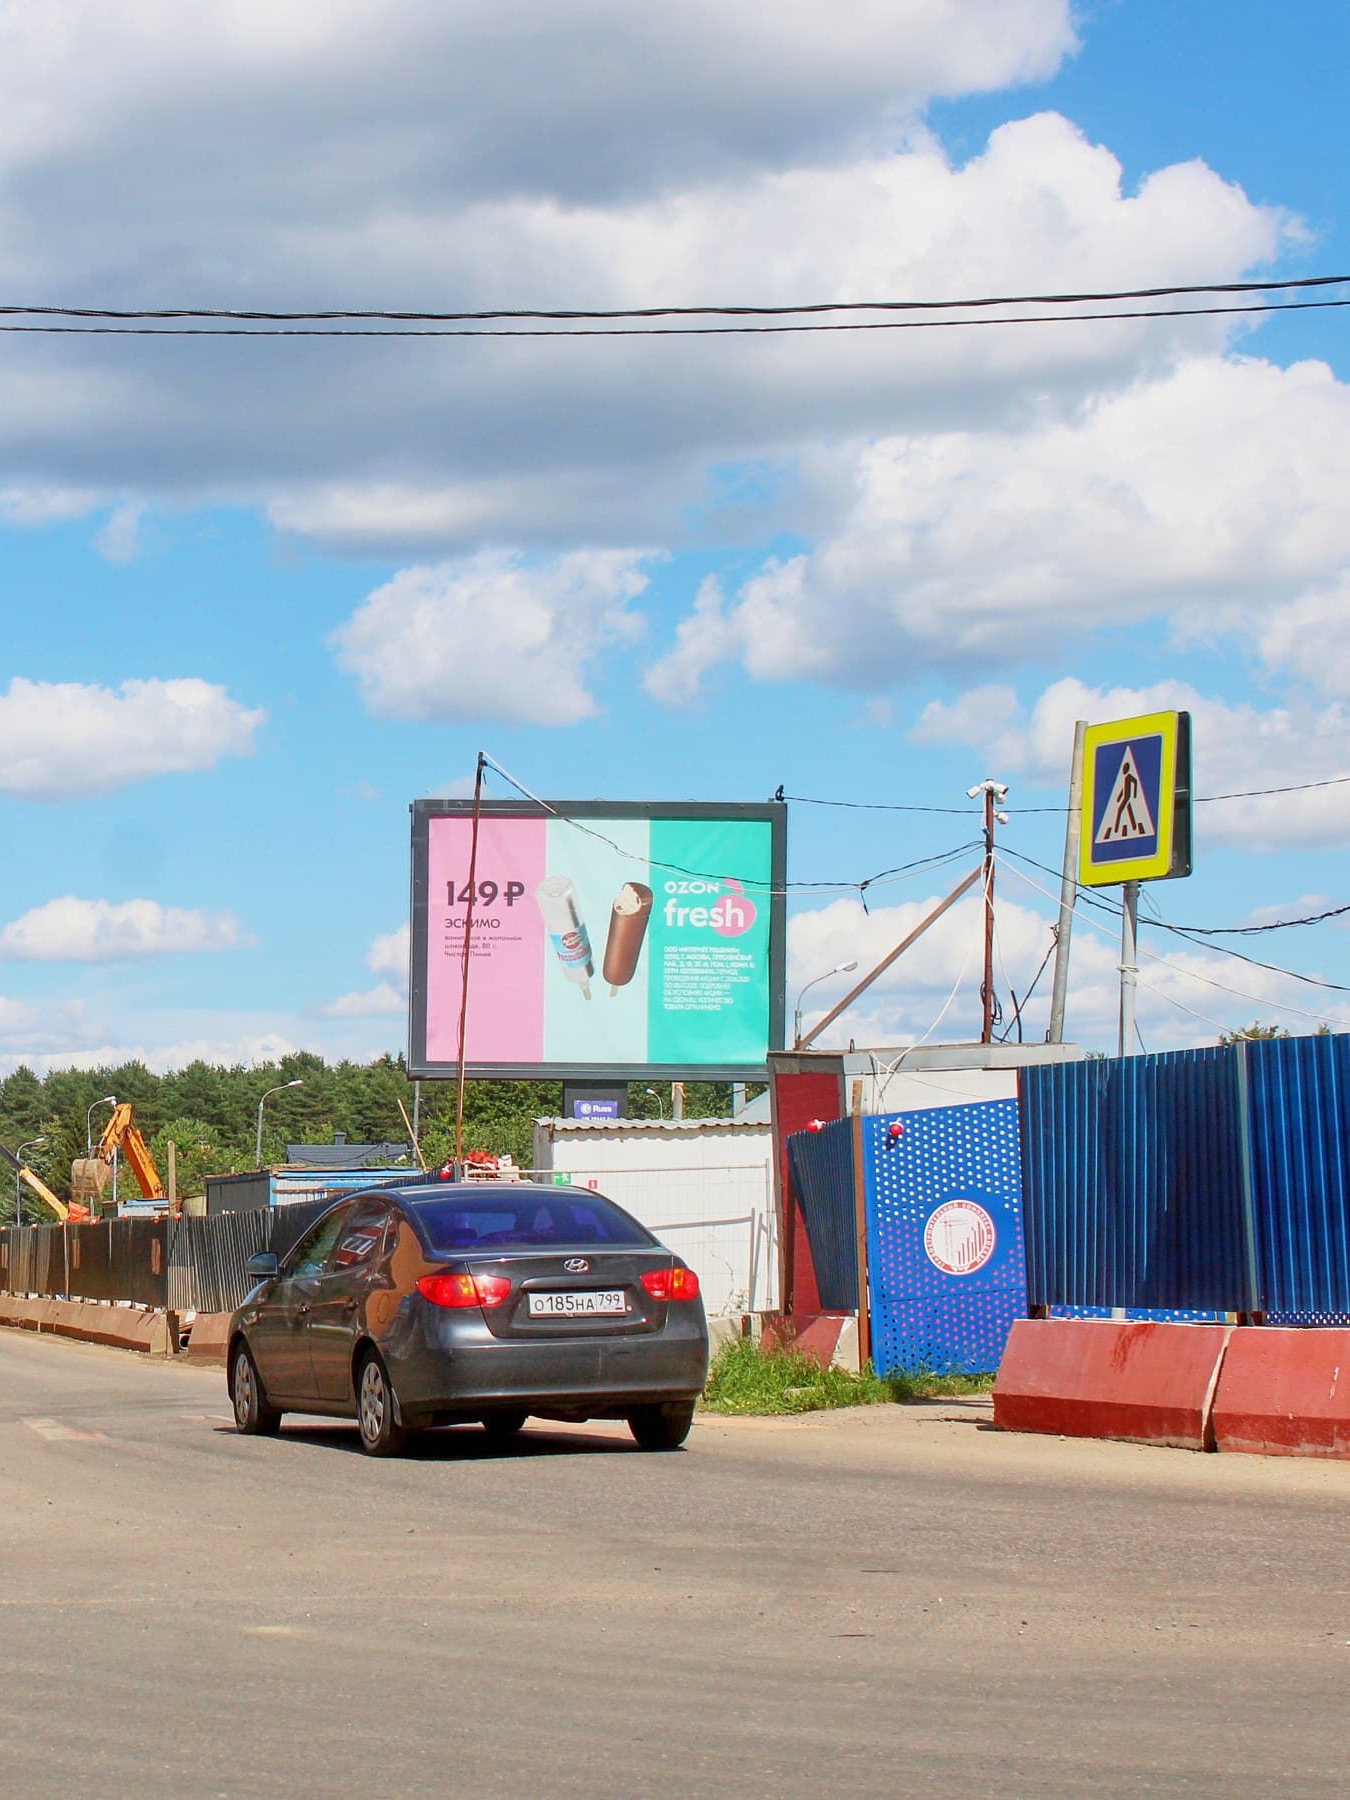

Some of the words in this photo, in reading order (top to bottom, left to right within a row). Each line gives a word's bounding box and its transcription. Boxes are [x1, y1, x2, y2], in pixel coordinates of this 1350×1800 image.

[446, 881, 498, 906] 149
[663, 898, 745, 928] fresh
[598, 1294, 620, 1306] 799
